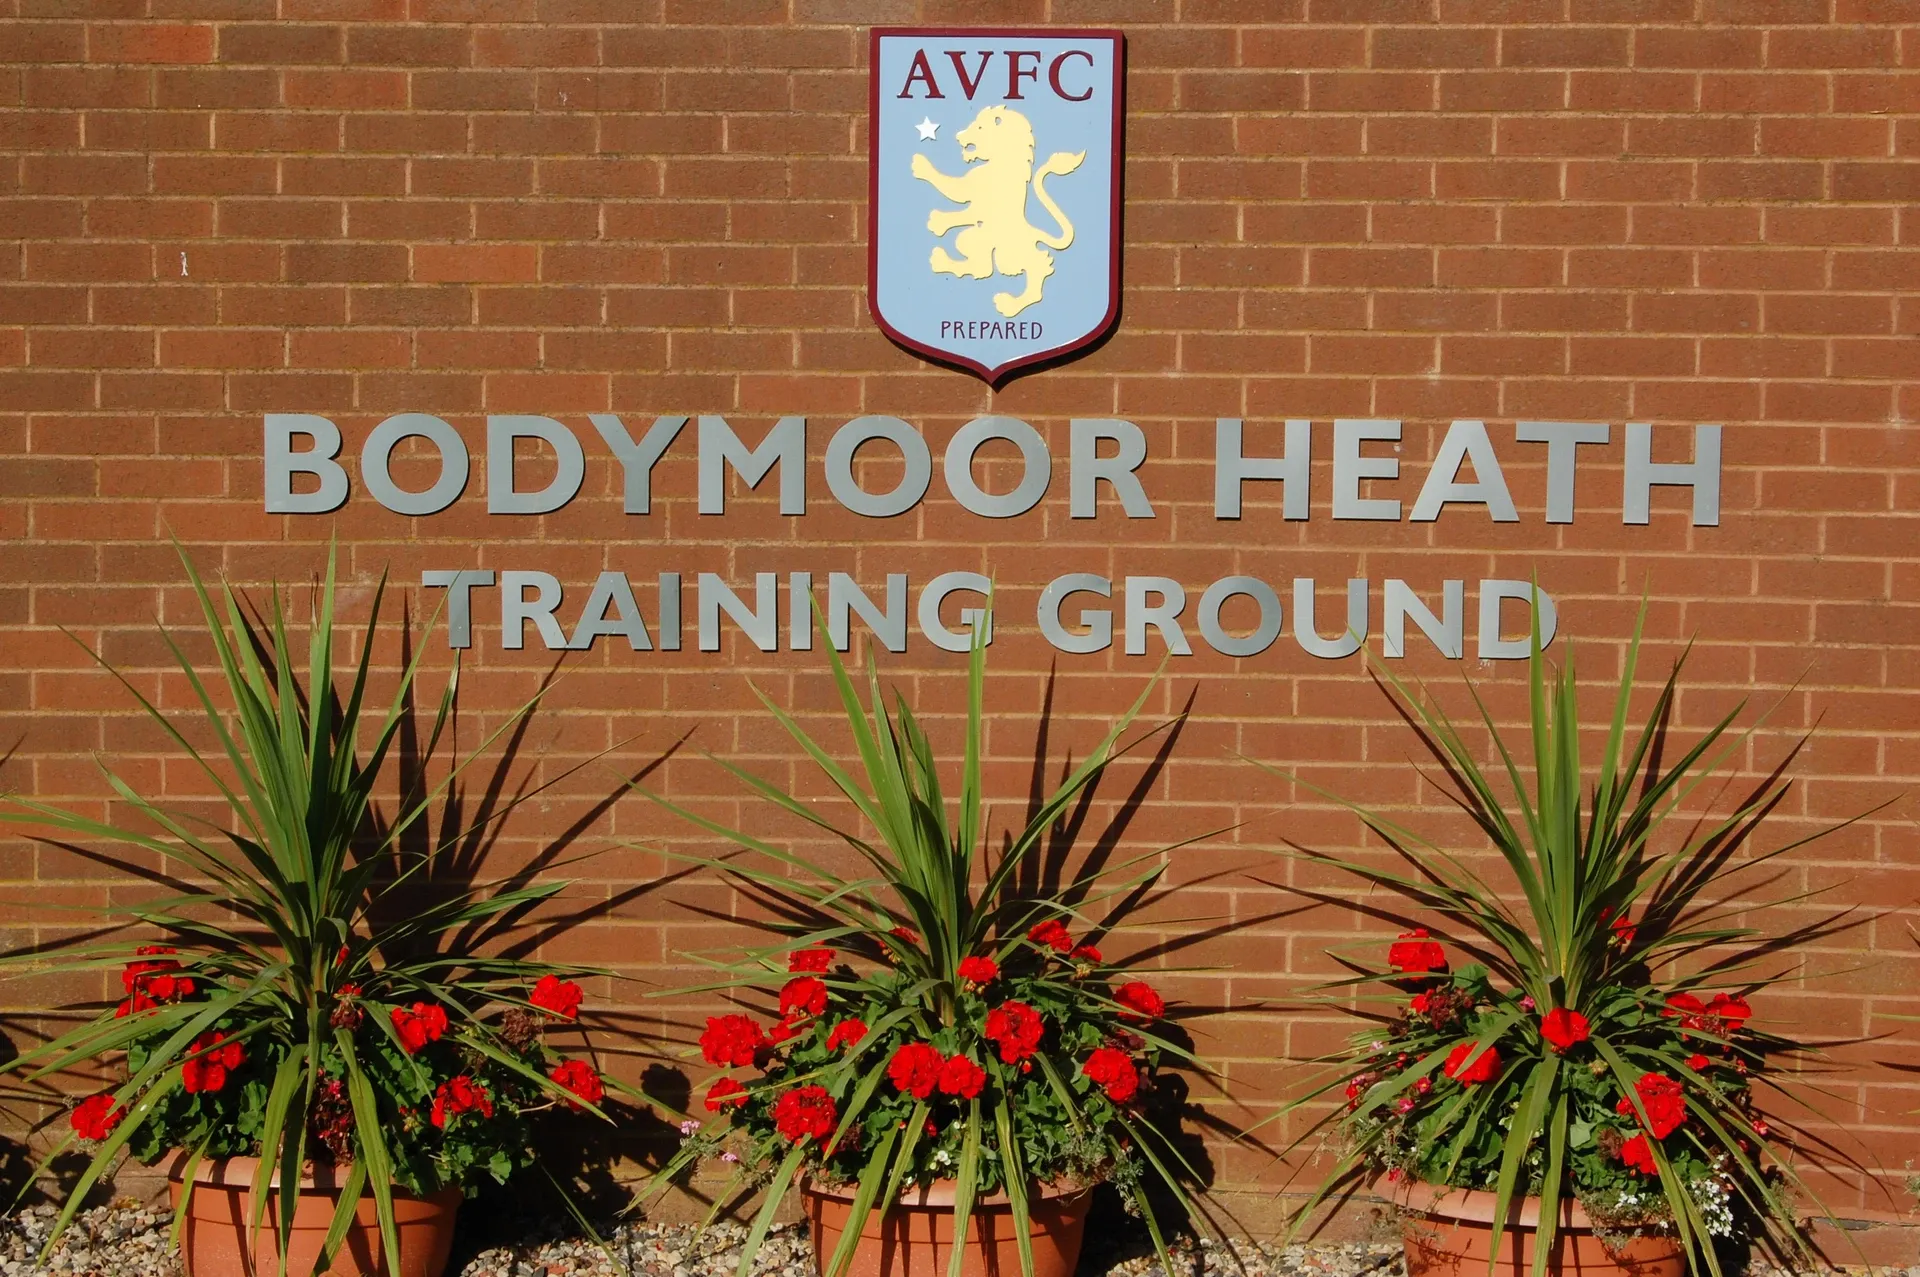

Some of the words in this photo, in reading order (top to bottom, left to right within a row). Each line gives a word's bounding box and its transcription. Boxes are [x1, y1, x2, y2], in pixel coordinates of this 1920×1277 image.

[897, 48, 1094, 101] AVFC
[941, 321, 1043, 340] PREPARED
[264, 412, 1156, 519] BODYMOOR
[1214, 418, 1723, 527] HEATH
[421, 570, 994, 653] TRAINING
[1037, 573, 1558, 660] GROUND
